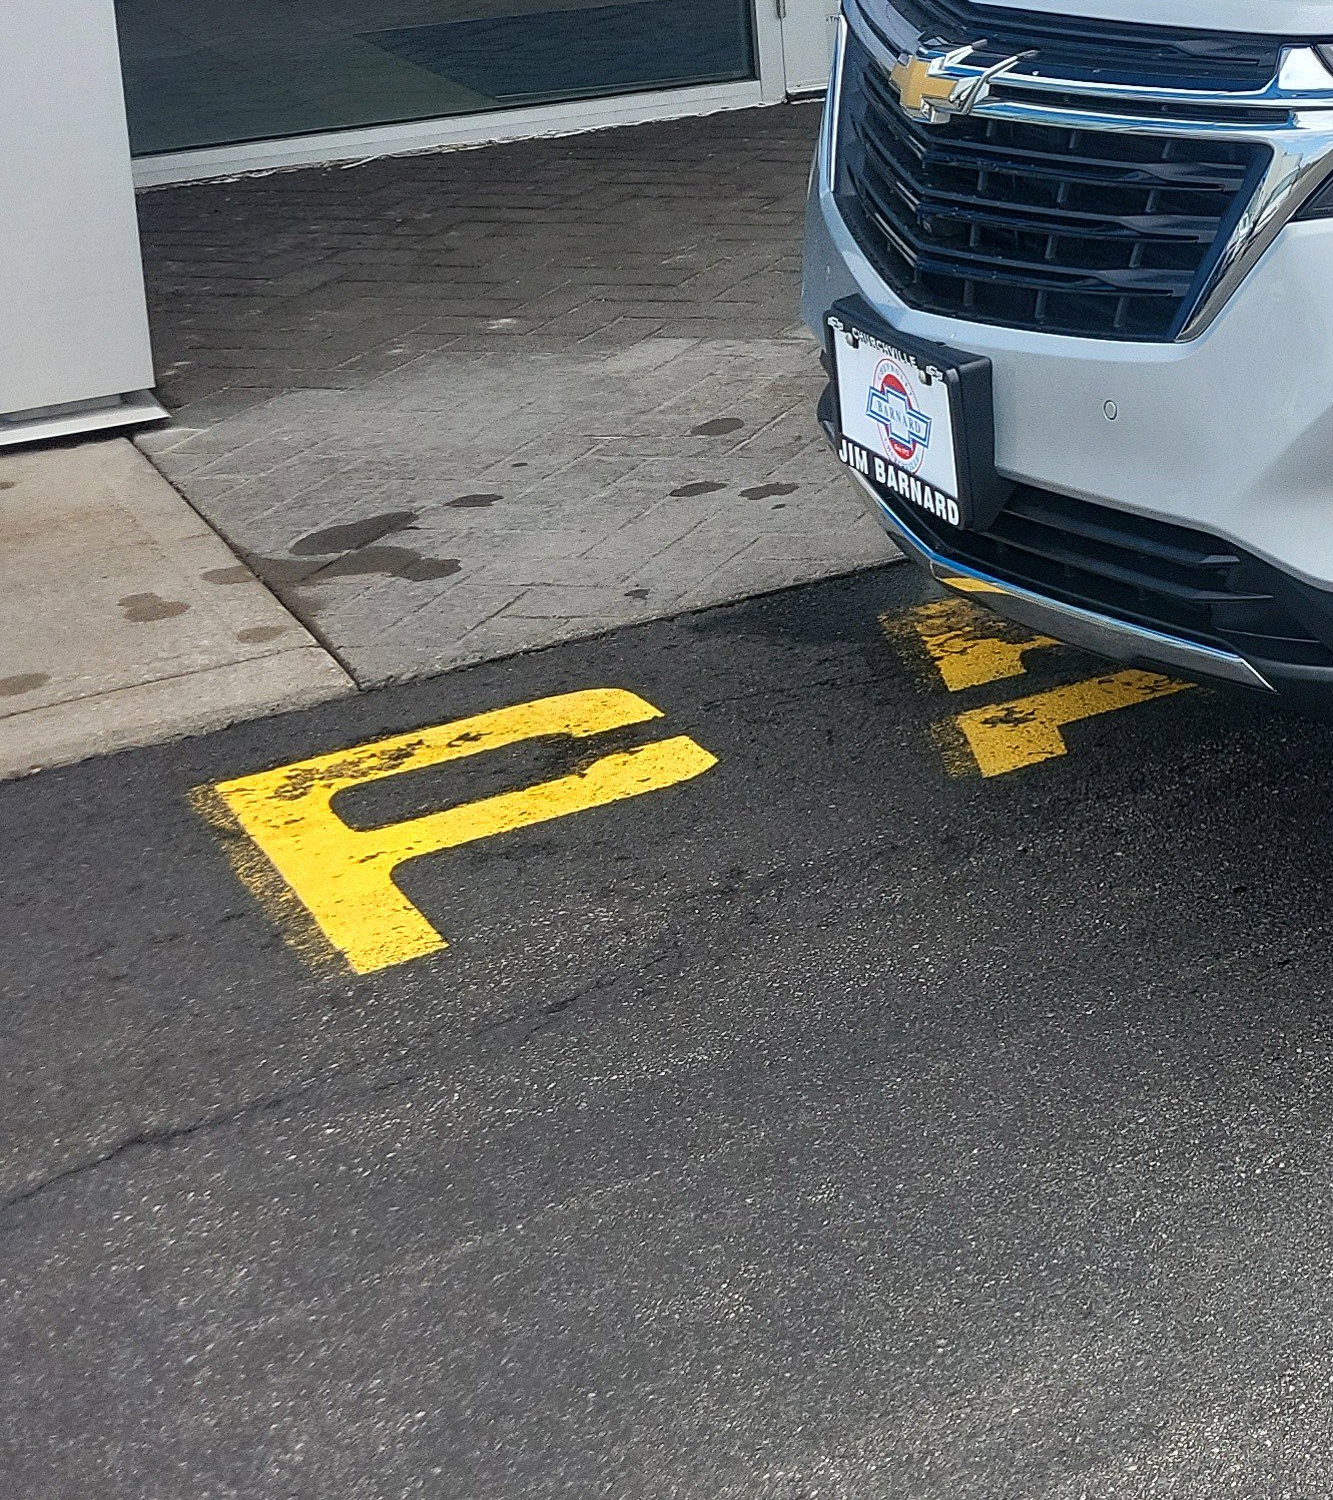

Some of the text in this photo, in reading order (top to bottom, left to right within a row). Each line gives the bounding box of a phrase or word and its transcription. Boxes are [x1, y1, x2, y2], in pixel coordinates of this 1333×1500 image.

[851, 327, 919, 371] CHURCHVILLE
[876, 400, 921, 434] BARNARD
[838, 439, 869, 475] JIM
[874, 457, 960, 526] BARNARD
